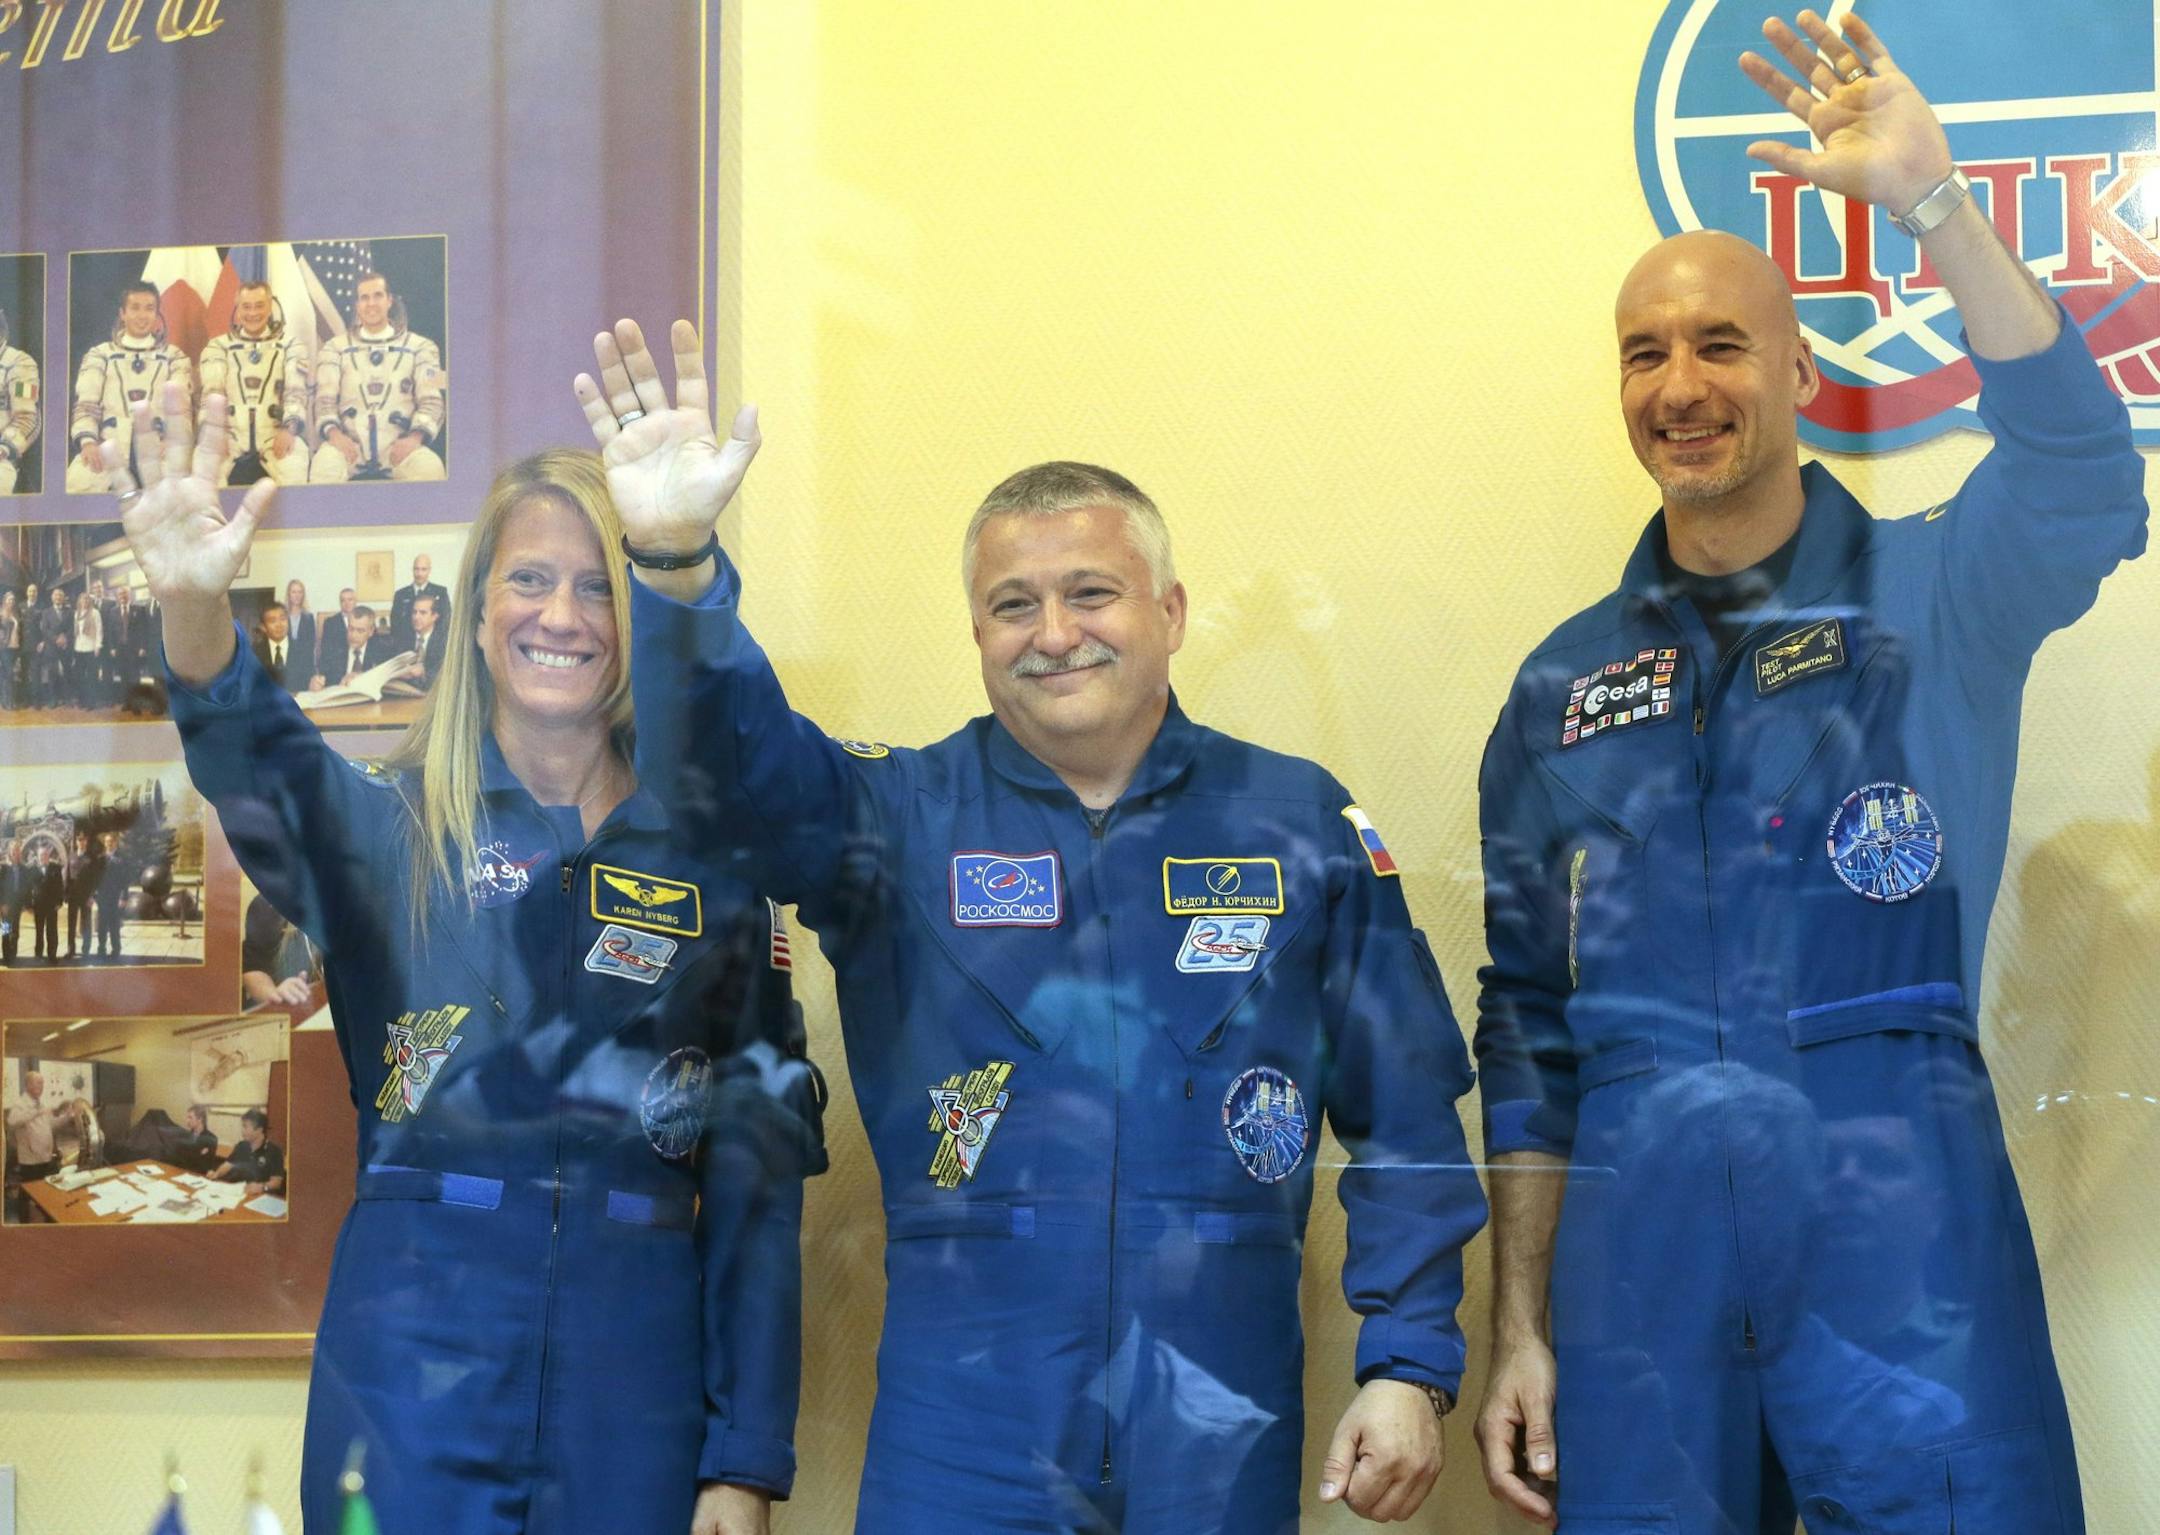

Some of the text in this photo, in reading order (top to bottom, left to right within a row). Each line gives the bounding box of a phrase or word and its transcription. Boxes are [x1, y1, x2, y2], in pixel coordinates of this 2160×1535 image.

[1761, 658, 1780, 671] TEST
[1761, 663, 1782, 677] PILOT
[1767, 653, 1832, 685] LUCA PARMITANO
[469, 862, 529, 883] NASA
[1173, 895, 1208, 908] ФЁДОР
[1225, 896, 1277, 907] ЮРЧИХИН
[613, 904, 680, 925] KAREN NYBERG
[958, 903, 1055, 919] РОСКОСМОС
[1187, 921, 1257, 963] 25
